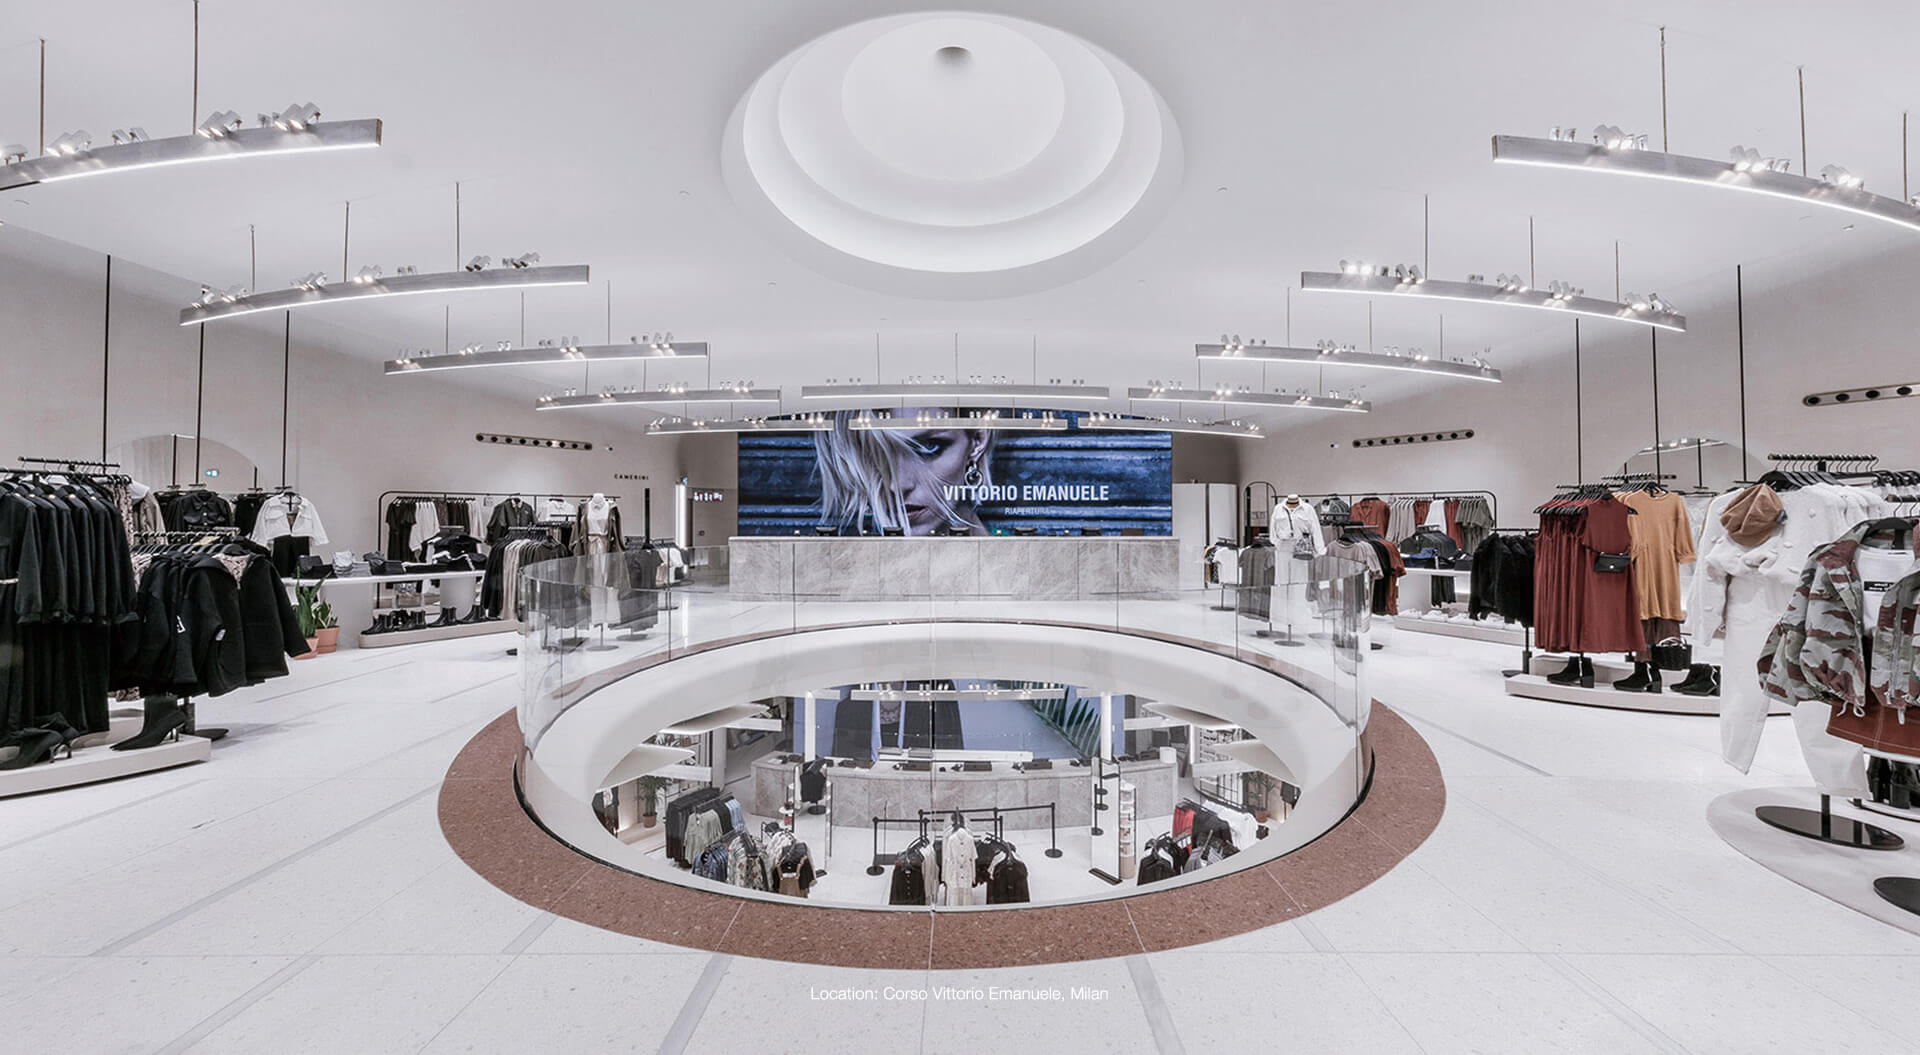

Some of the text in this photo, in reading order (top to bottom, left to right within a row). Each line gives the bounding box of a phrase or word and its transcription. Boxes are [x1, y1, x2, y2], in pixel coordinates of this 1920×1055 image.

[613, 473, 649, 481] CAMERINI
[943, 485, 1109, 501] VITTORIO EMANUELE
